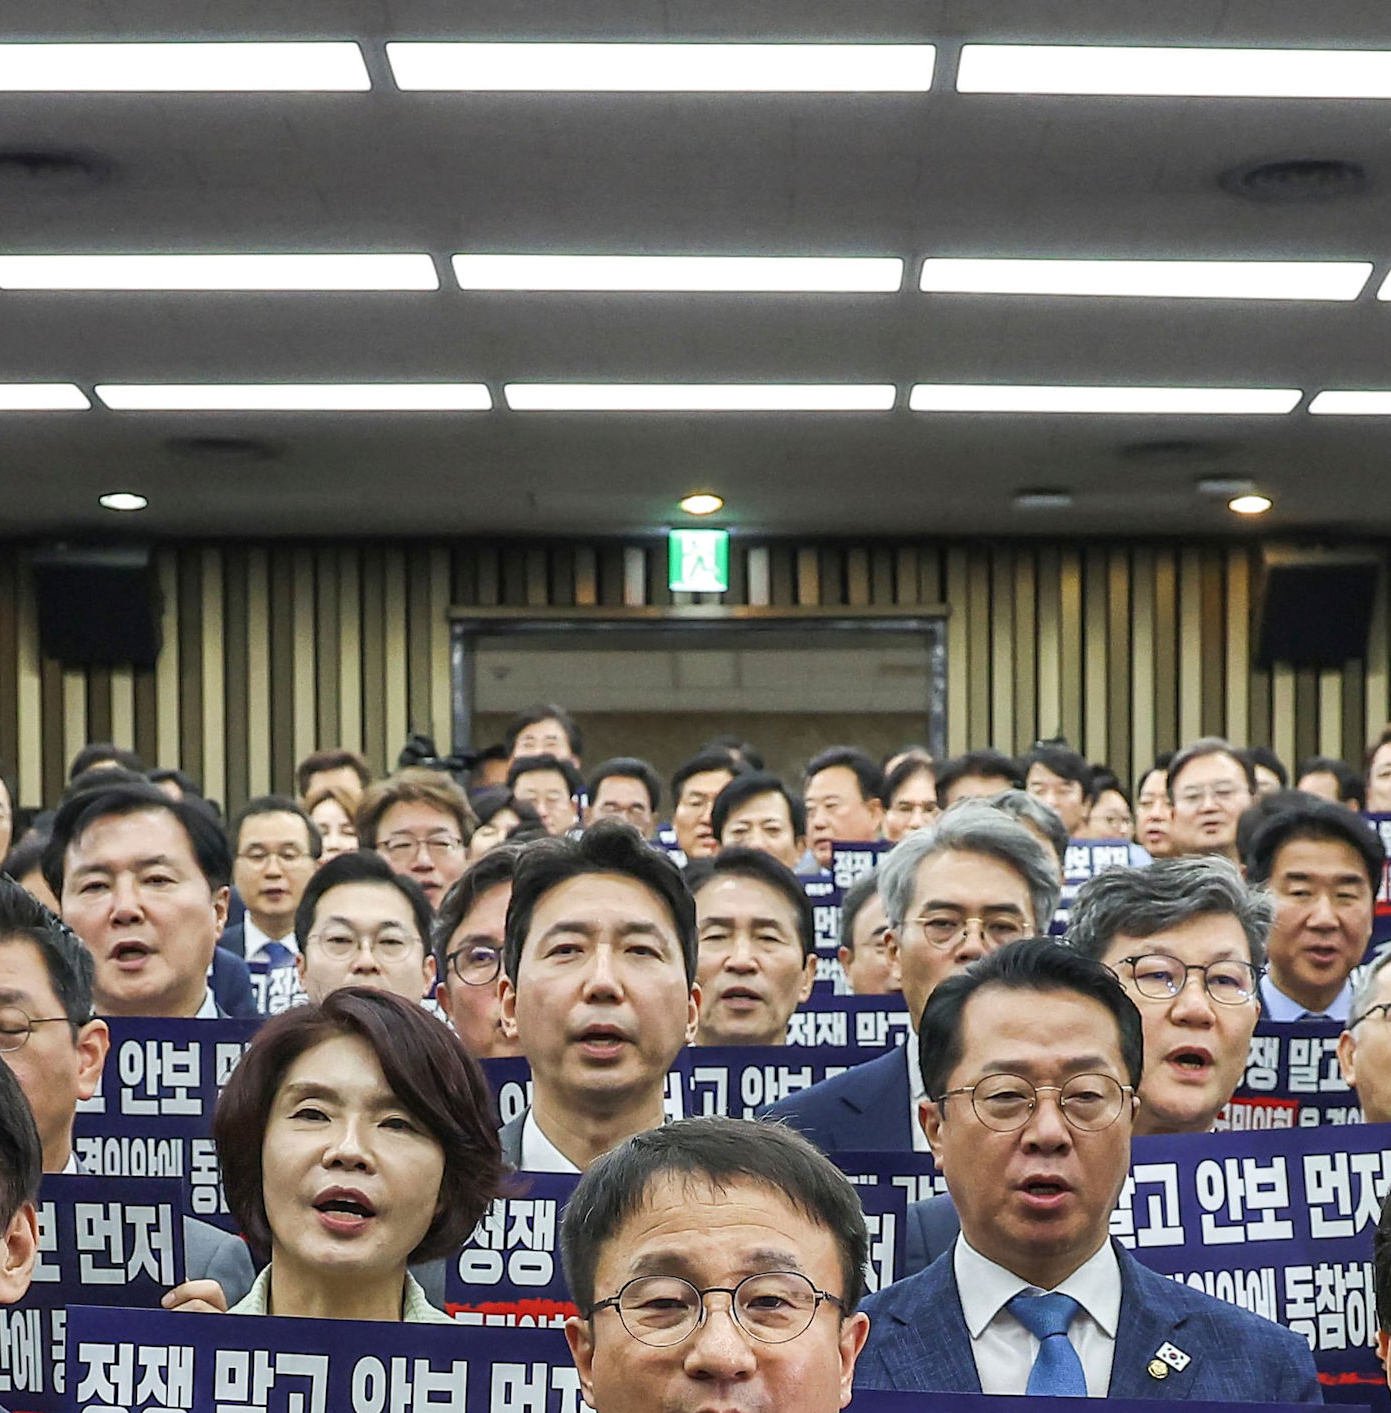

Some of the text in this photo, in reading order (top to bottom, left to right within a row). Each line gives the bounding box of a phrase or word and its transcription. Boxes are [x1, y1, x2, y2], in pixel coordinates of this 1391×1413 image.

[119, 1040, 202, 1115] 안보
[1196, 1156, 1294, 1245] 안보
[74, 1202, 175, 1286] 먼저
[1285, 1261, 1377, 1352] 동참하
